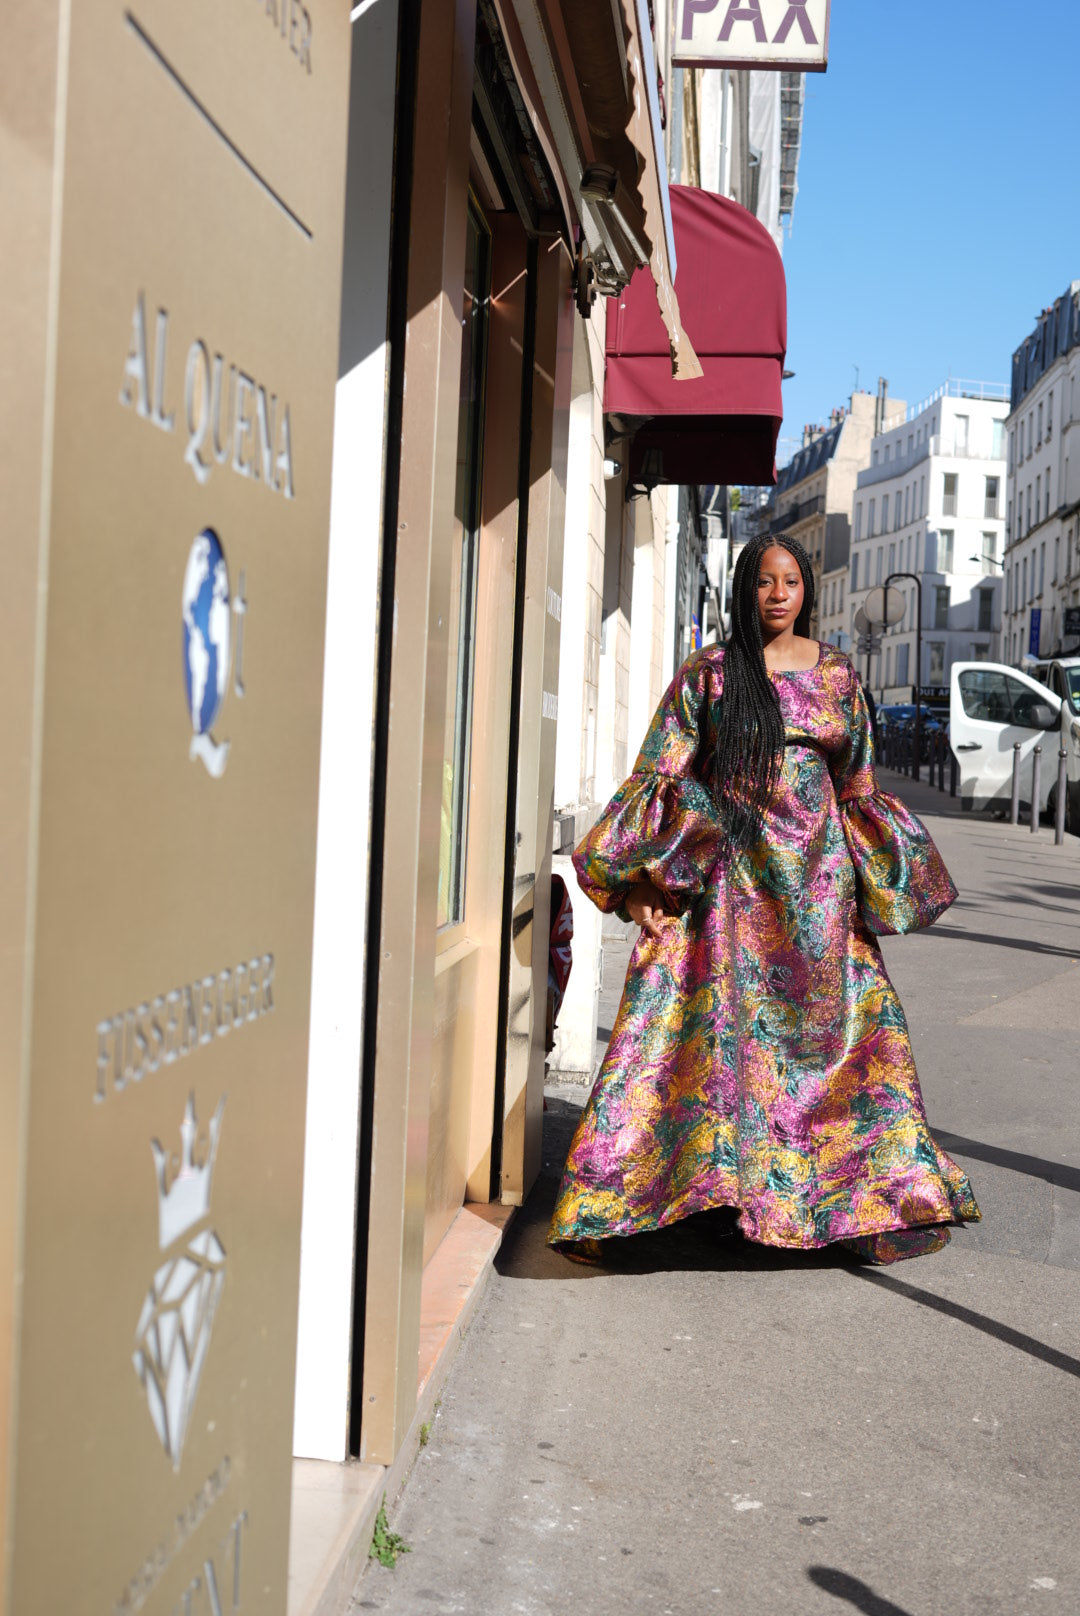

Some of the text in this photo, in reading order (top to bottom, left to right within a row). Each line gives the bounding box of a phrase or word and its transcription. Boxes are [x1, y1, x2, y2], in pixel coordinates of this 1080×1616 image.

[681, 0, 819, 45] PAX
[120, 288, 294, 500] AL QUENA
[93, 954, 275, 1104] FUSSENEGGER
